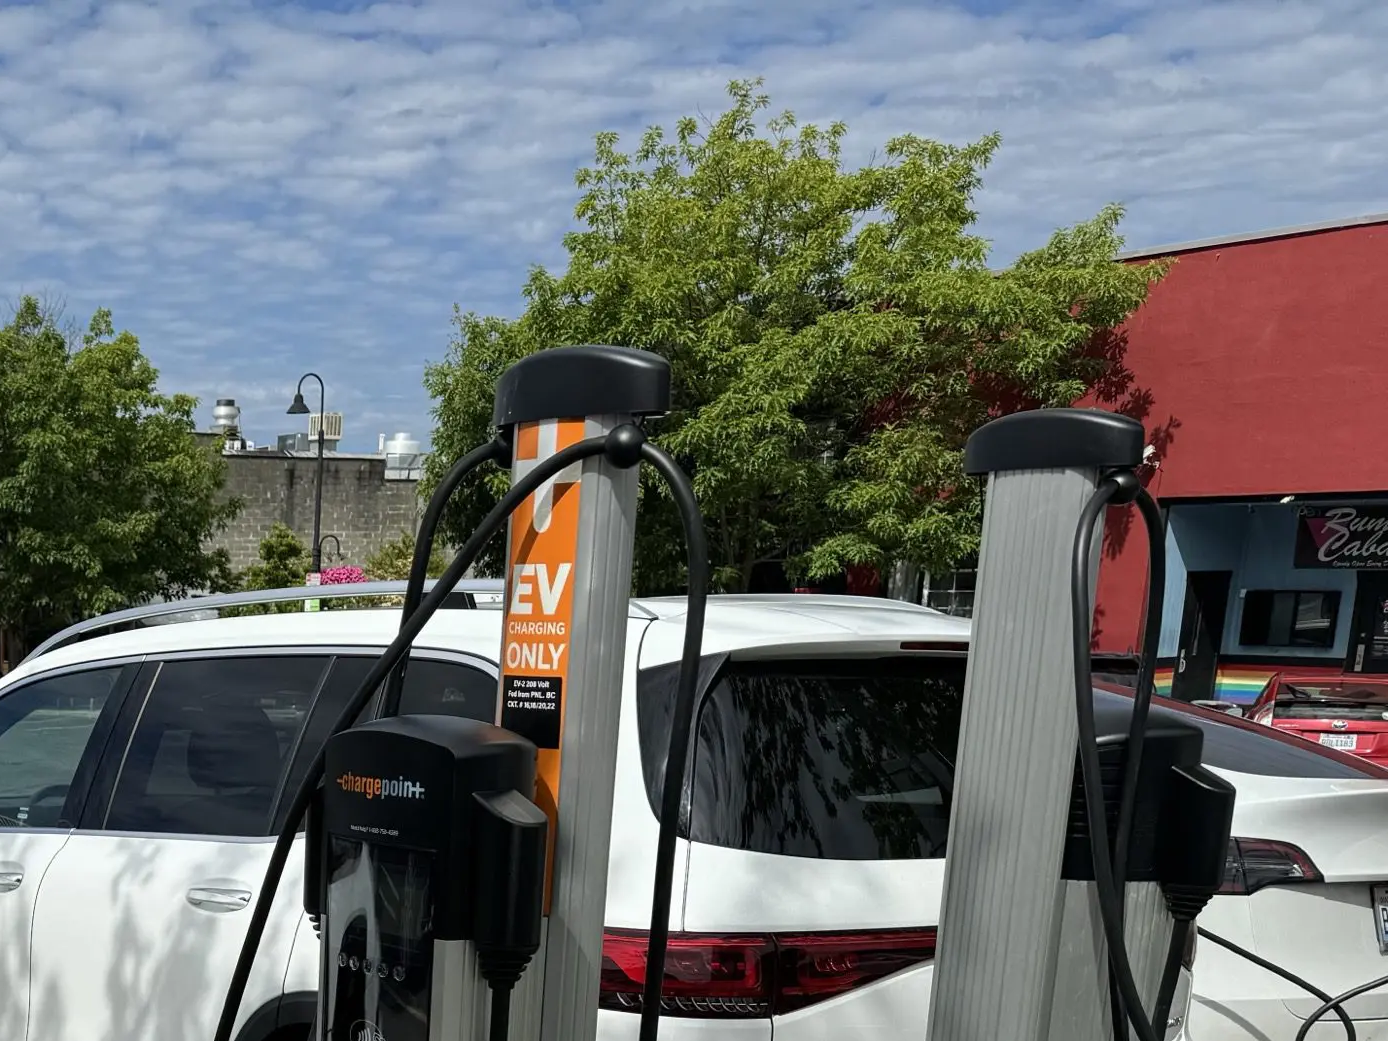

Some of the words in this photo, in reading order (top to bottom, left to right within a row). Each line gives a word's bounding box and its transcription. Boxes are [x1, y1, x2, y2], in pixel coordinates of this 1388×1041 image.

[510, 563, 572, 615] EV
[508, 621, 565, 635] CHARGING
[506, 641, 567, 670] ONLY
[518, 690, 529, 698] from
